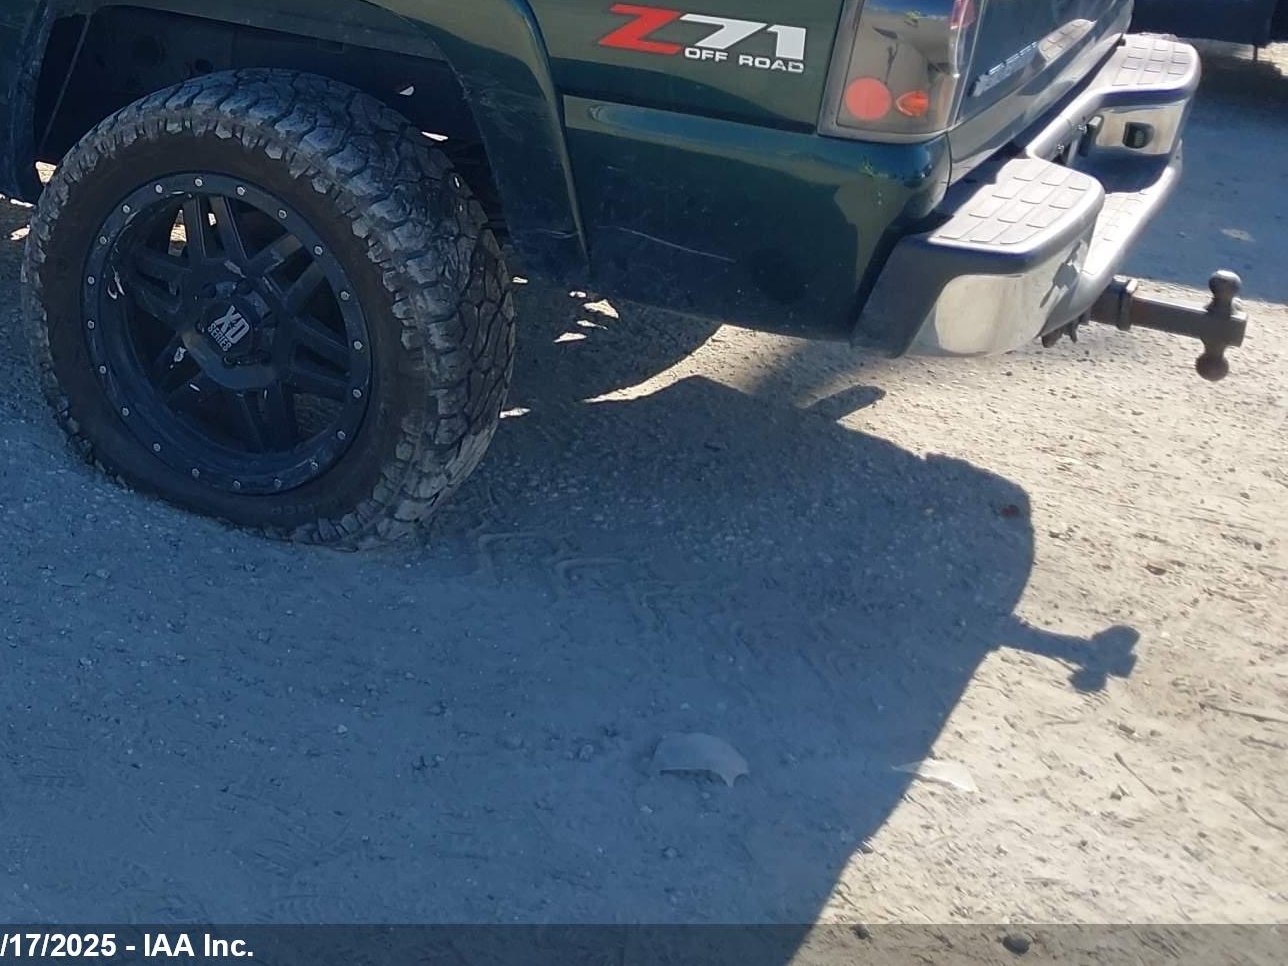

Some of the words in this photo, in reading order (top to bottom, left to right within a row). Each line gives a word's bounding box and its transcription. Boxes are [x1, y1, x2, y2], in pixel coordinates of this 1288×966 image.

[598, 2, 808, 60] Z71
[684, 47, 728, 63] OFF
[738, 56, 805, 74] ROAD
[207, 322, 232, 352] SERIES
[214, 305, 250, 344] XD
